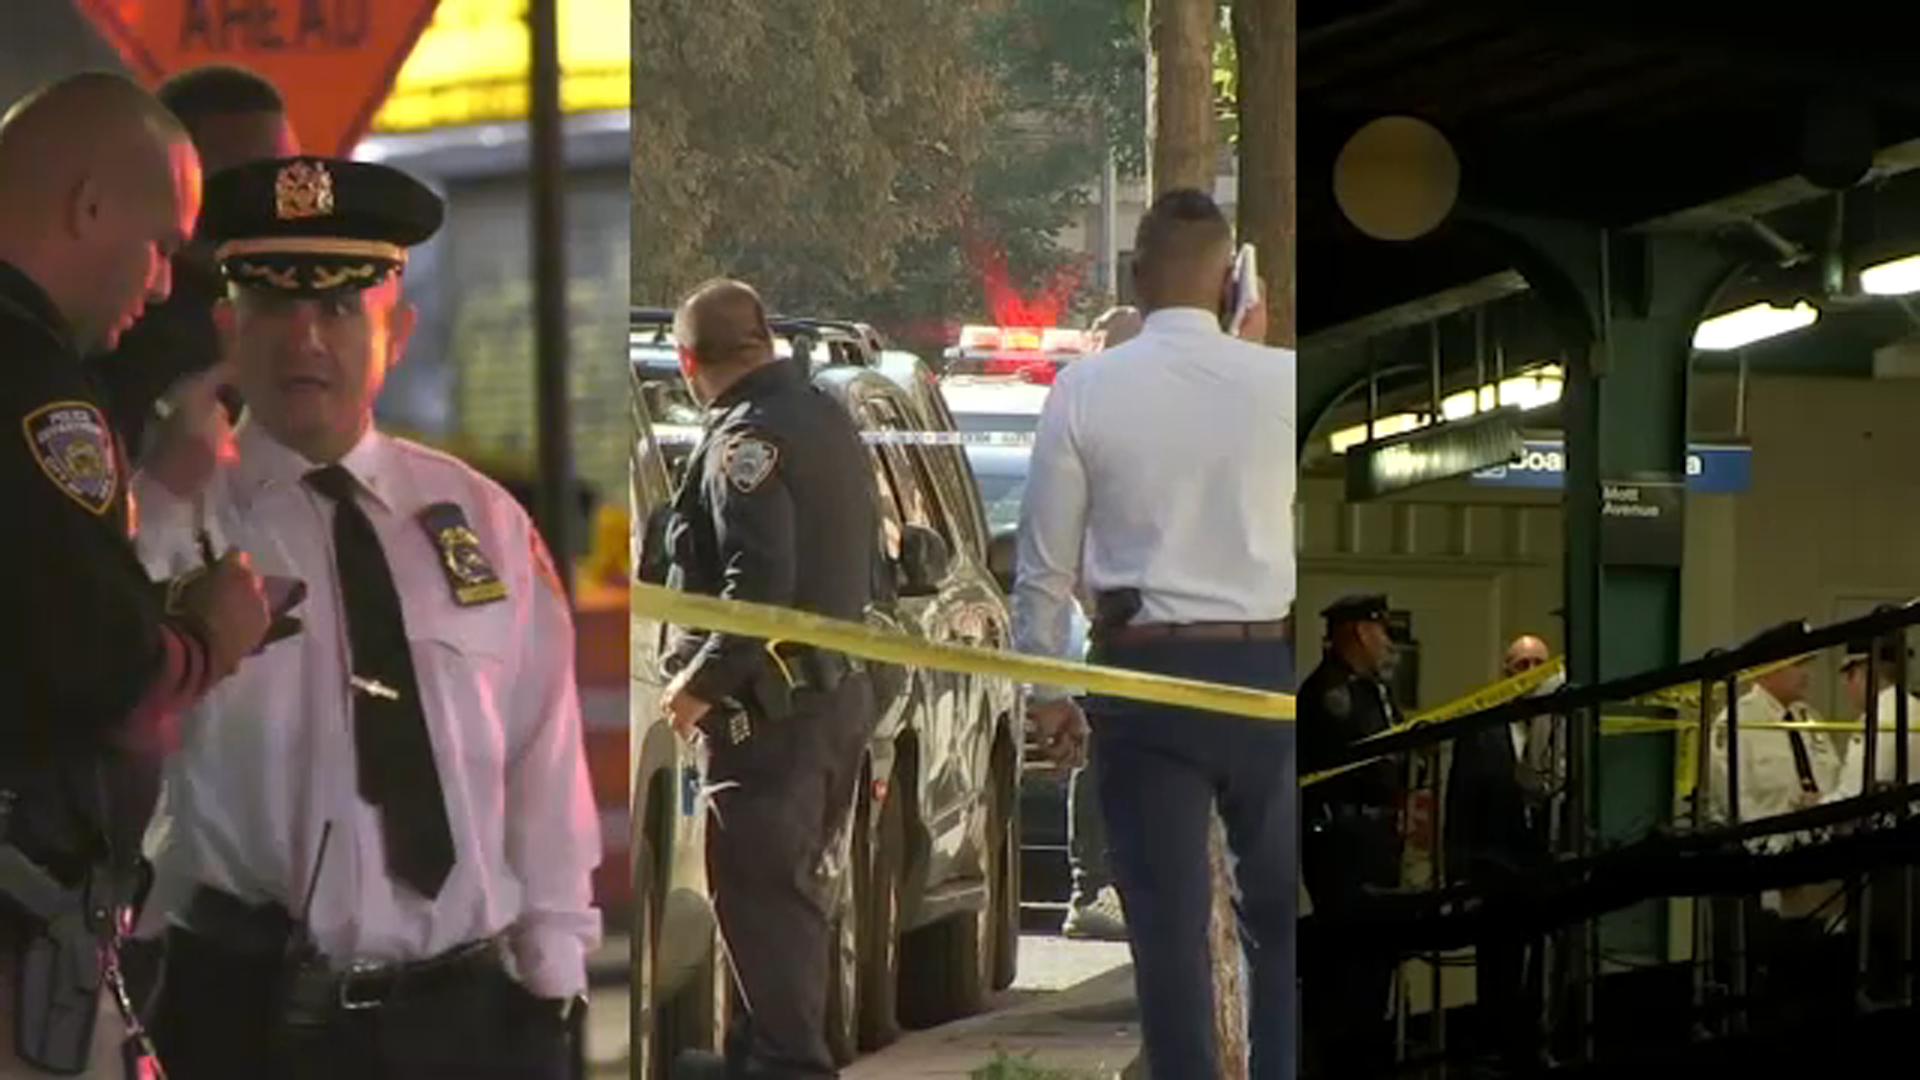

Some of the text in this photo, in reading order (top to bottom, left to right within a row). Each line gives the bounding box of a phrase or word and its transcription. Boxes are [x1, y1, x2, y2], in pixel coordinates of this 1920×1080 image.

[179, 0, 370, 49] AHEAD
[1602, 486, 1640, 502] Mott
[1601, 500, 1660, 518] Avenue
